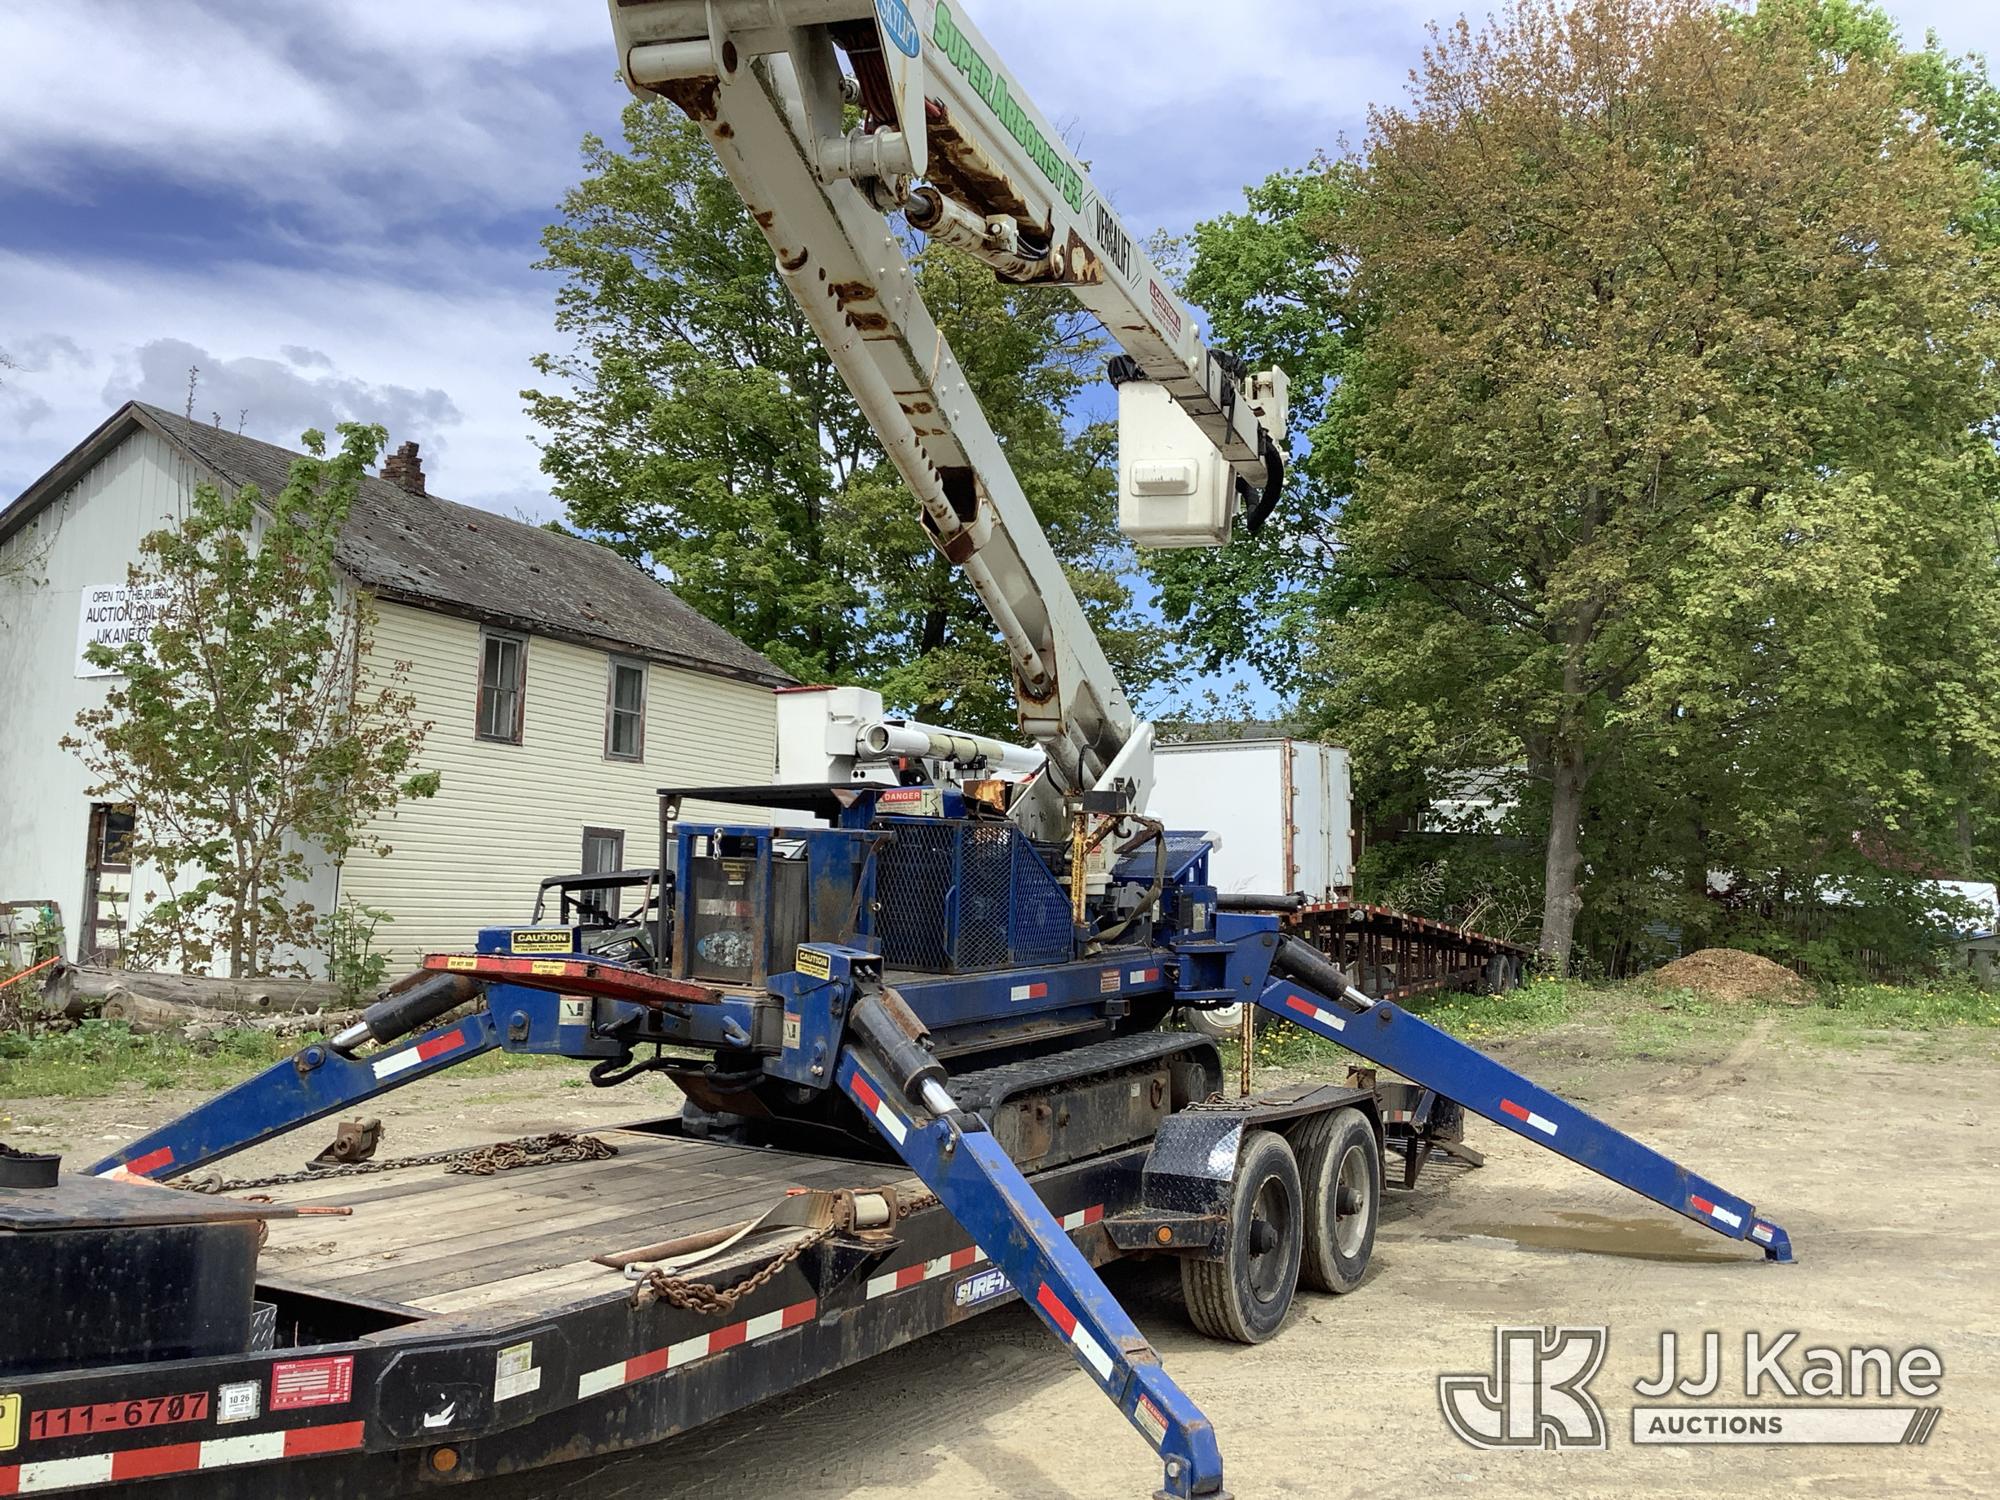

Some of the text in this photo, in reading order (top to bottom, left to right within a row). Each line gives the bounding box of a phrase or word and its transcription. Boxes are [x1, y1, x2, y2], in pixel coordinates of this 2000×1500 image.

[933, 1, 1083, 214] SUPER ARBORIST 53
[1096, 199, 1131, 281] VERSALIFT
[92, 591, 113, 602] OPEN
[115, 590, 125, 601] TO
[127, 588, 142, 600] THE
[86, 602, 178, 622] AUCTION ONLE
[94, 626, 153, 643] JJKANE.CO
[884, 792, 920, 801] DANGER
[517, 934, 567, 942] CAUTION
[799, 951, 828, 967] CAUTION
[956, 1270, 1011, 1306] SURE-T
[230, 1396, 239, 1404] 10
[35, 1393, 206, 1436] 111-6707
